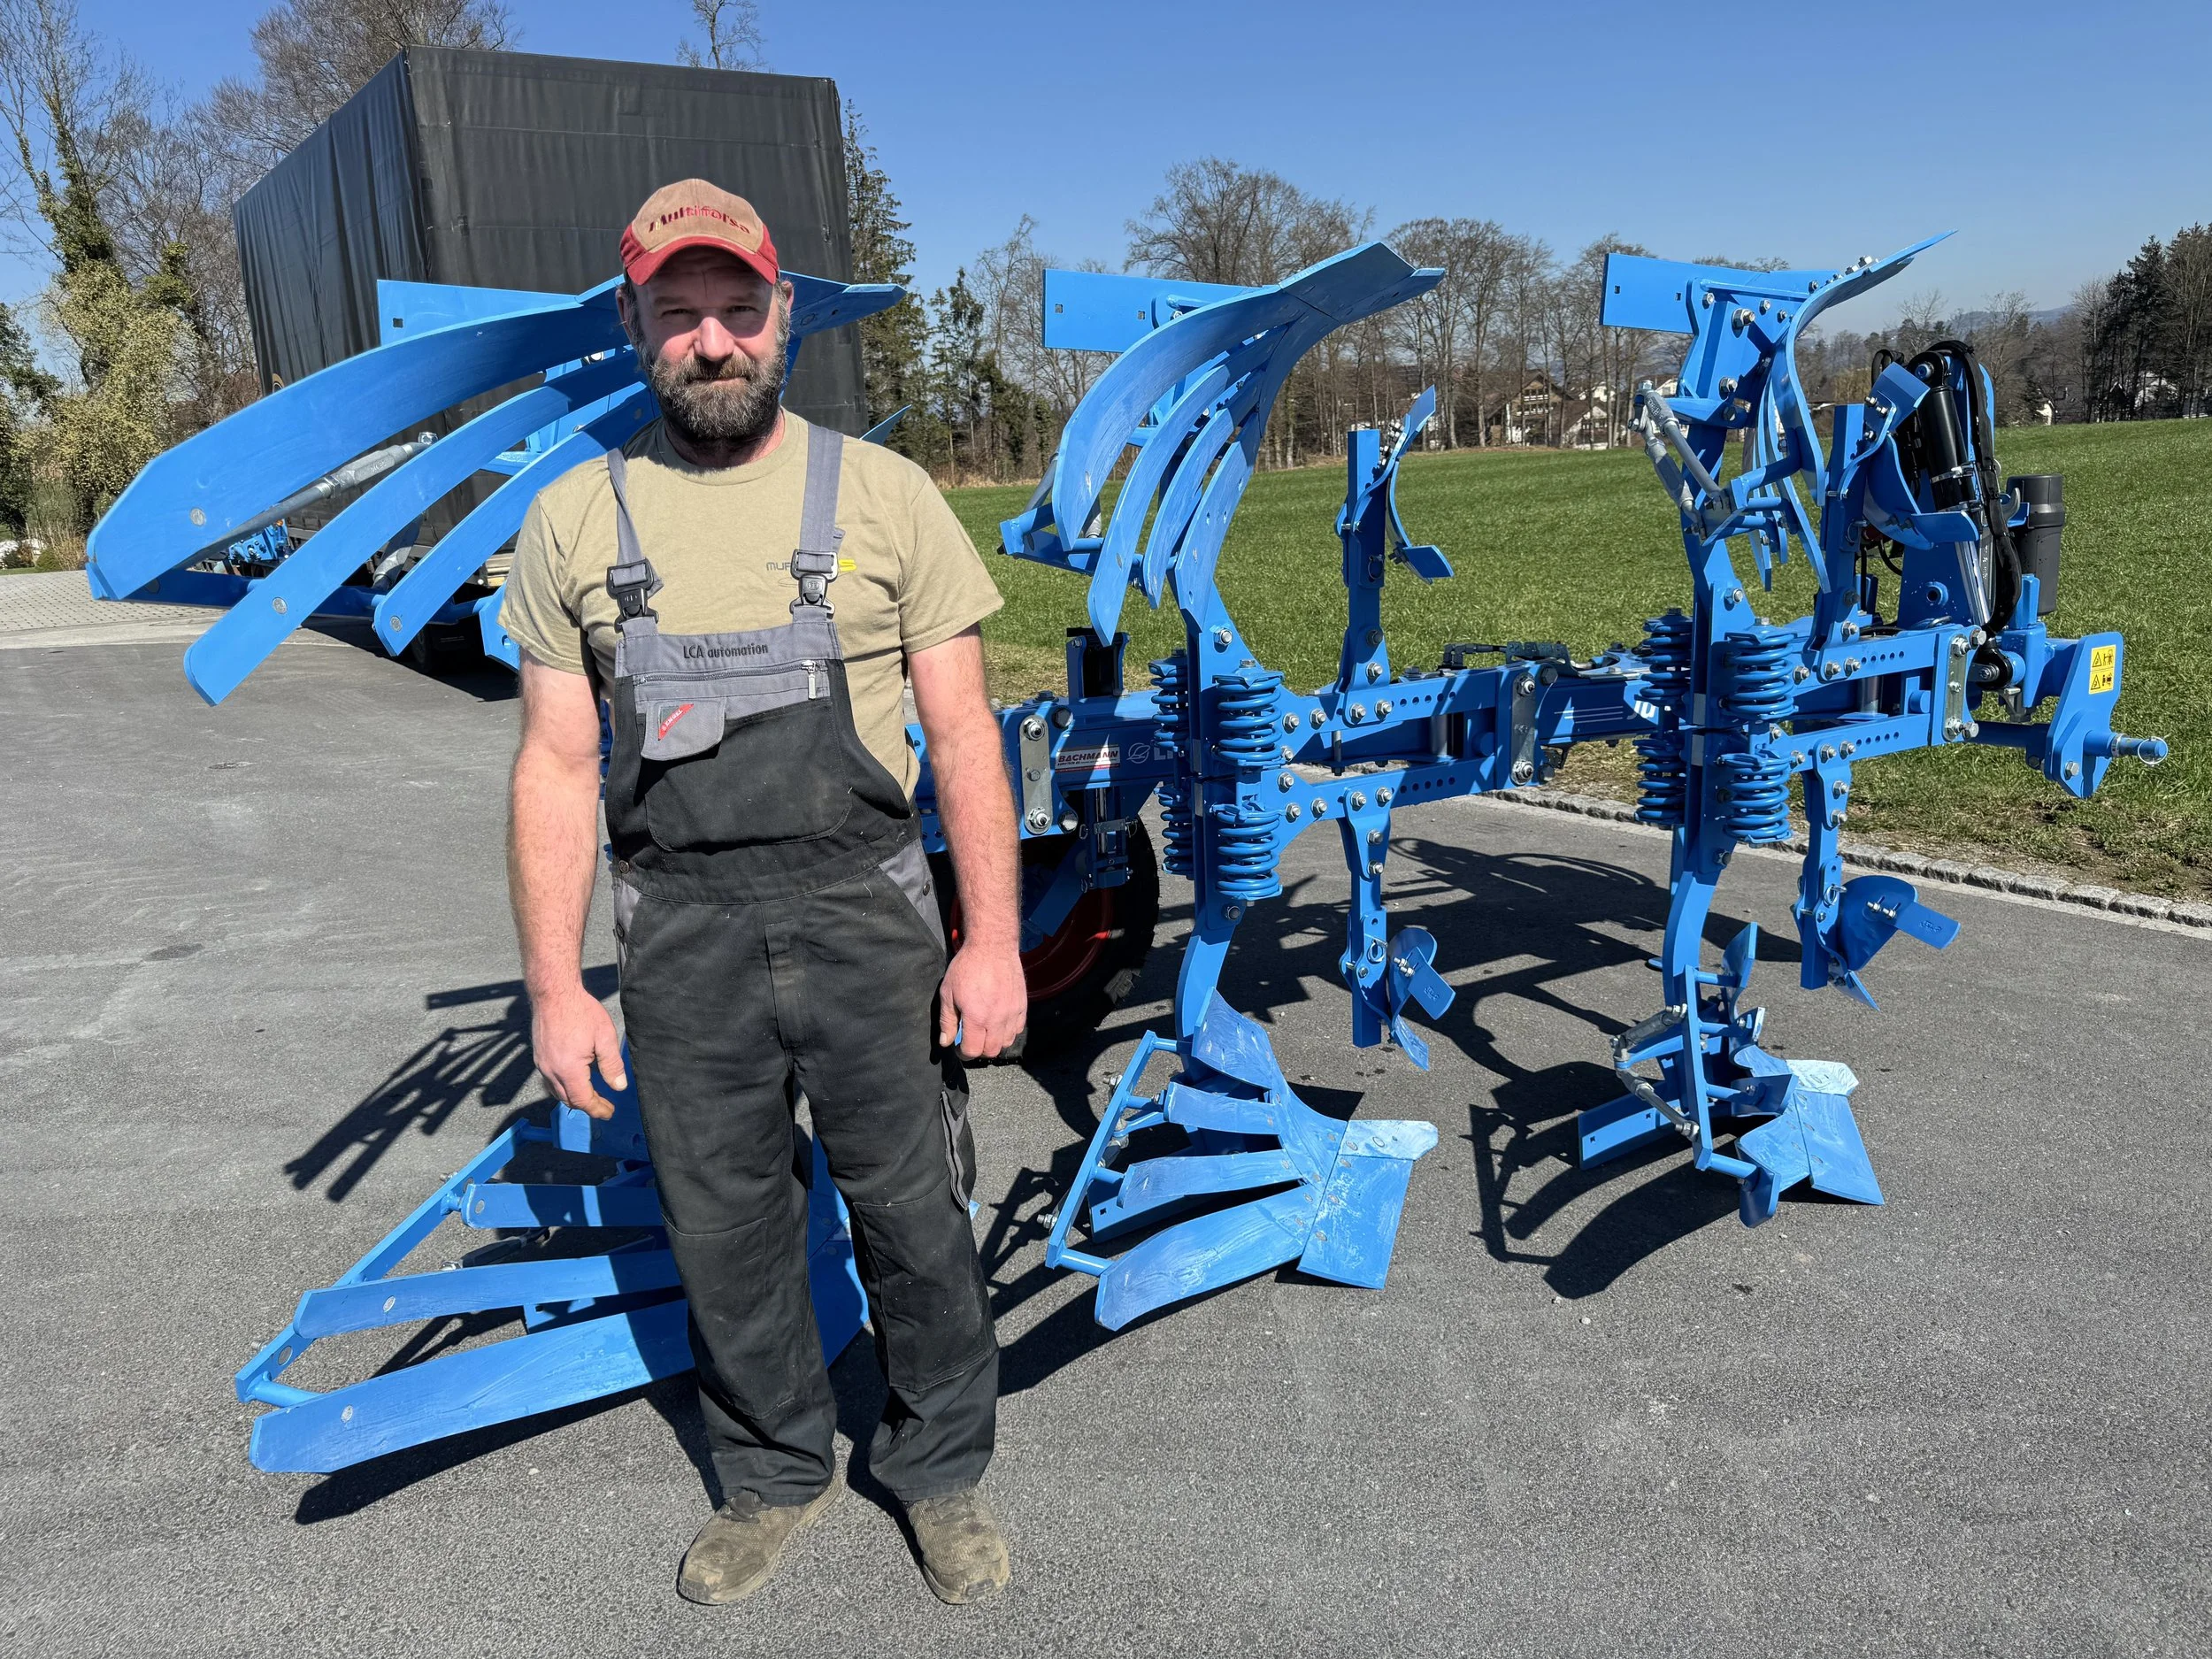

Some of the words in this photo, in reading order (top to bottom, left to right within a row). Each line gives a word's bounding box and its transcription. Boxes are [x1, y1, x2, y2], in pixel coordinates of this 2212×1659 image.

[683, 645, 704, 658] LCA
[708, 642, 768, 658] automation
[664, 709, 683, 726] ENGEL
[1058, 750, 1118, 762] BACHMANN
